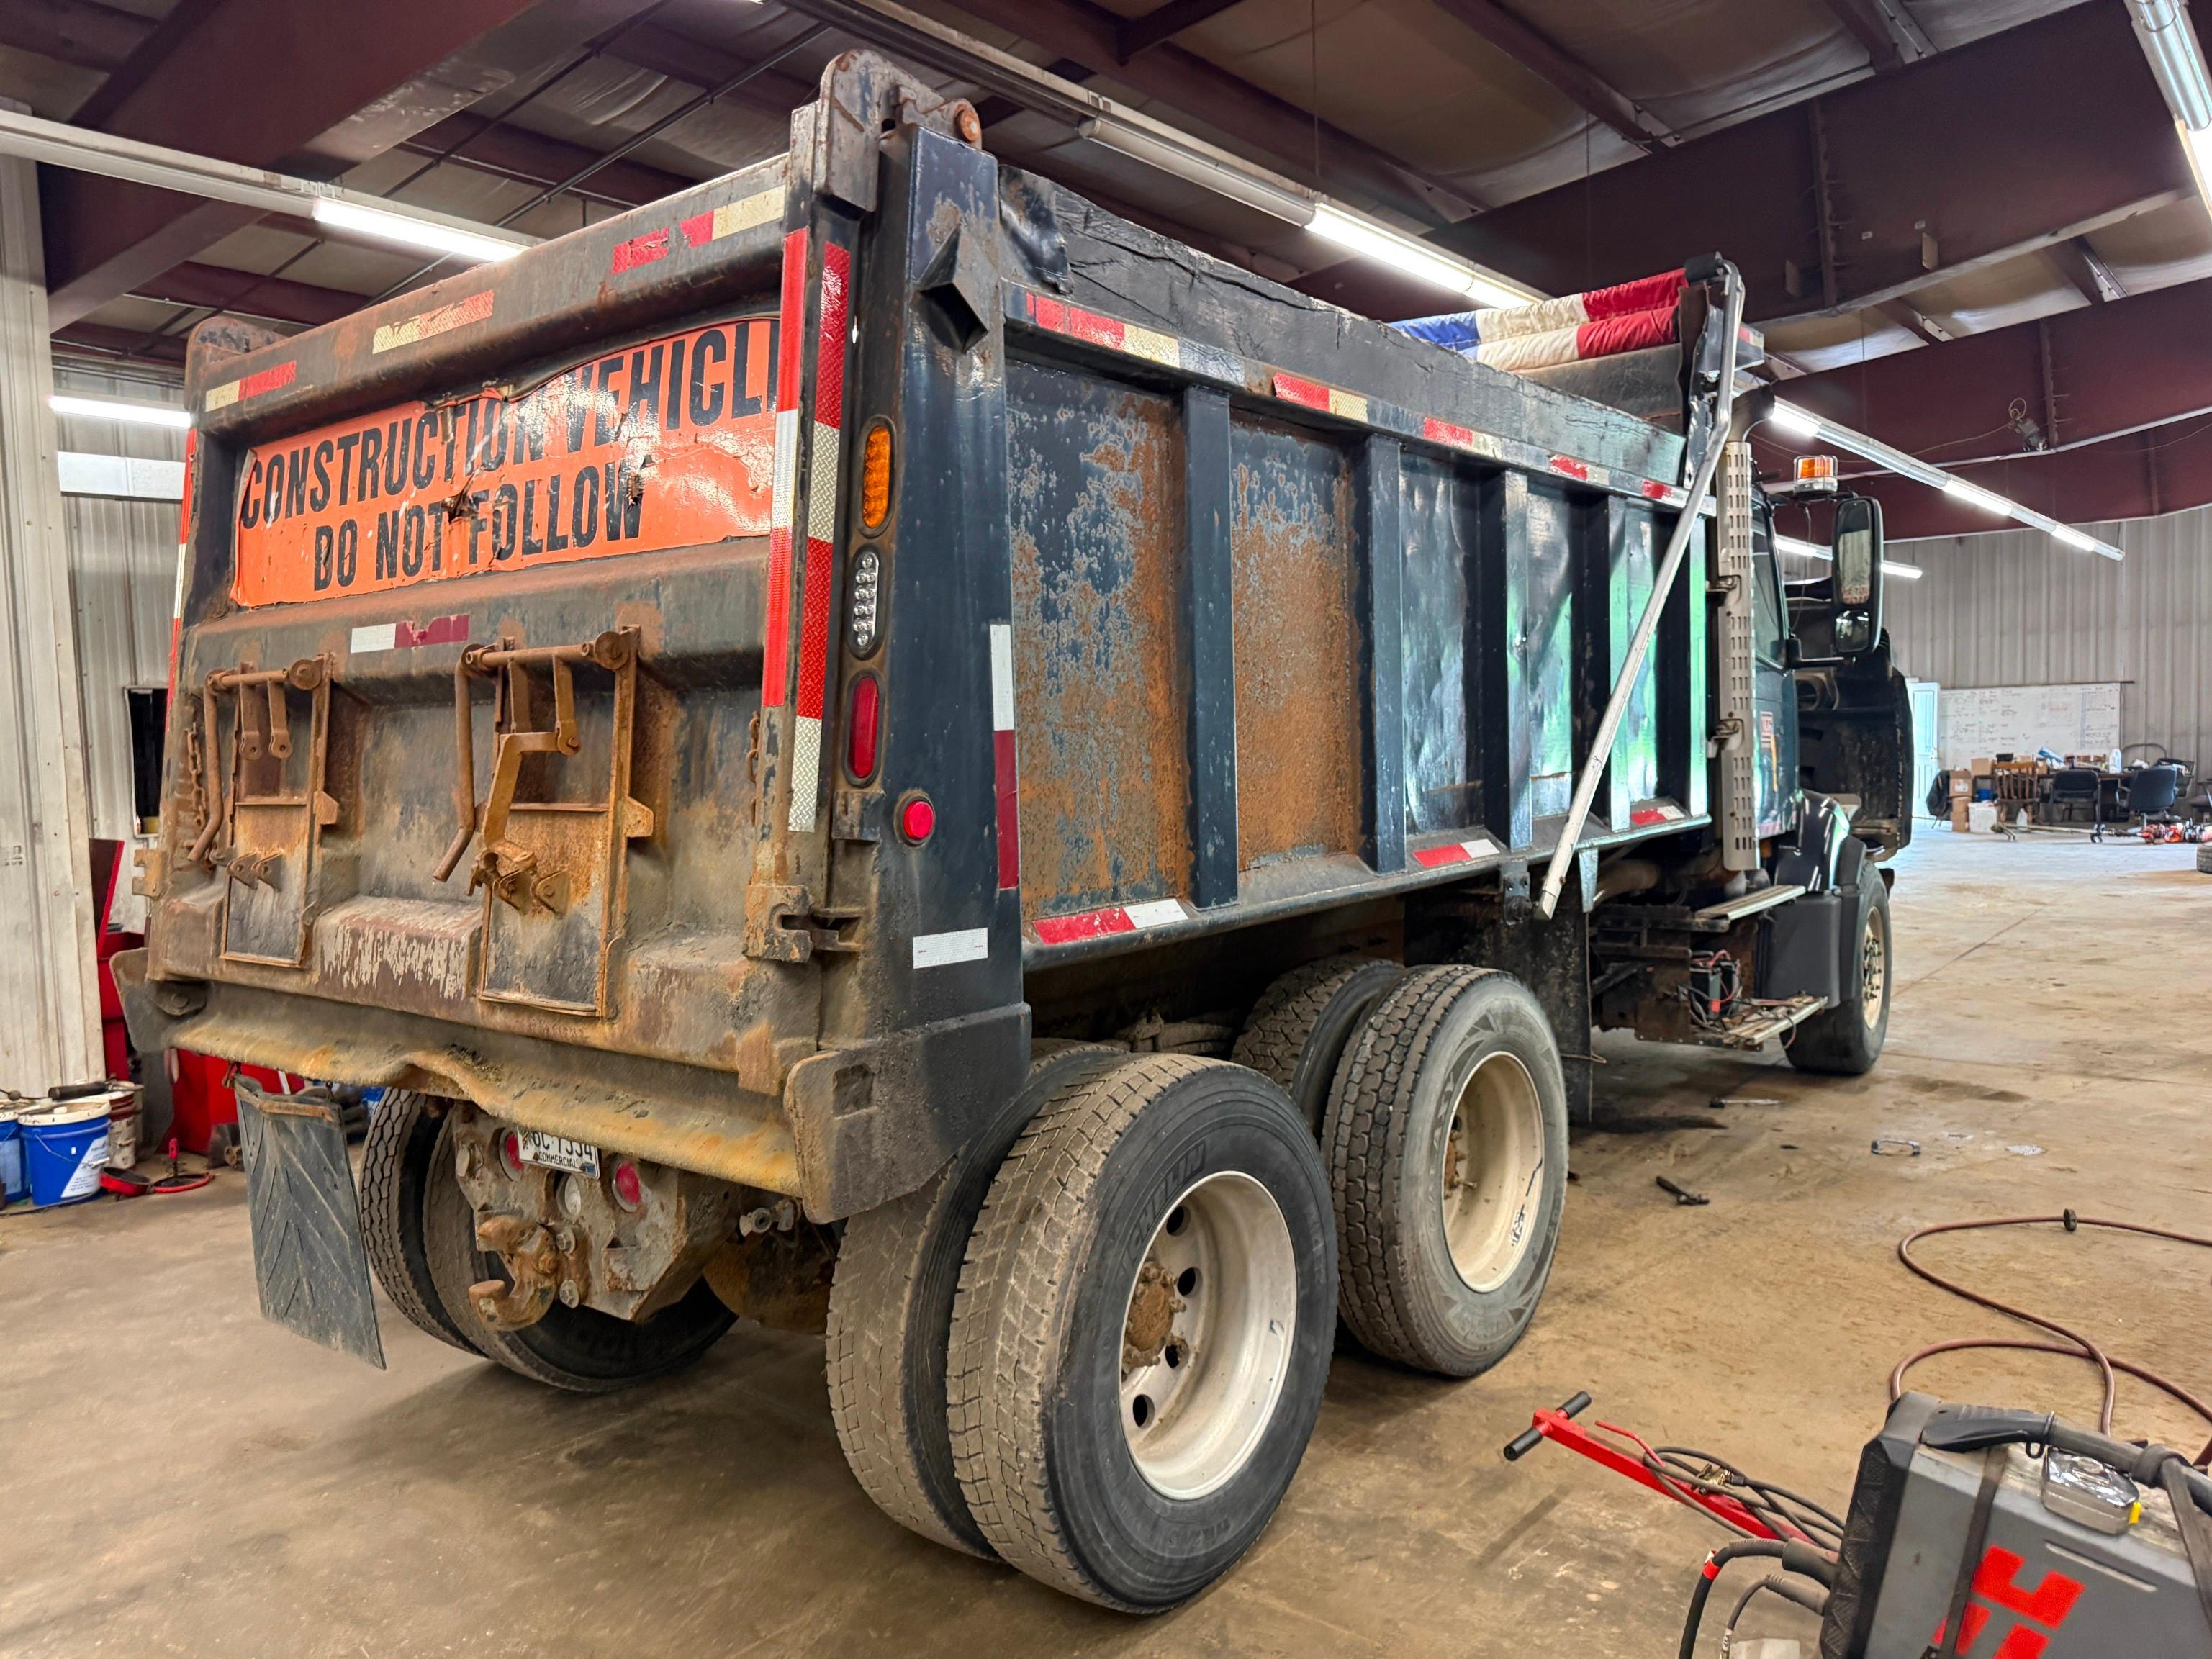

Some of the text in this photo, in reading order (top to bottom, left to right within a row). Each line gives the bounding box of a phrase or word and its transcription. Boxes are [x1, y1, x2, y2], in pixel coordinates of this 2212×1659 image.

[240, 394, 547, 529] CONSTRUCTION
[314, 455, 646, 591] DO NOT FOLLOW
[538, 1151, 578, 1168] COMMERCIAL
